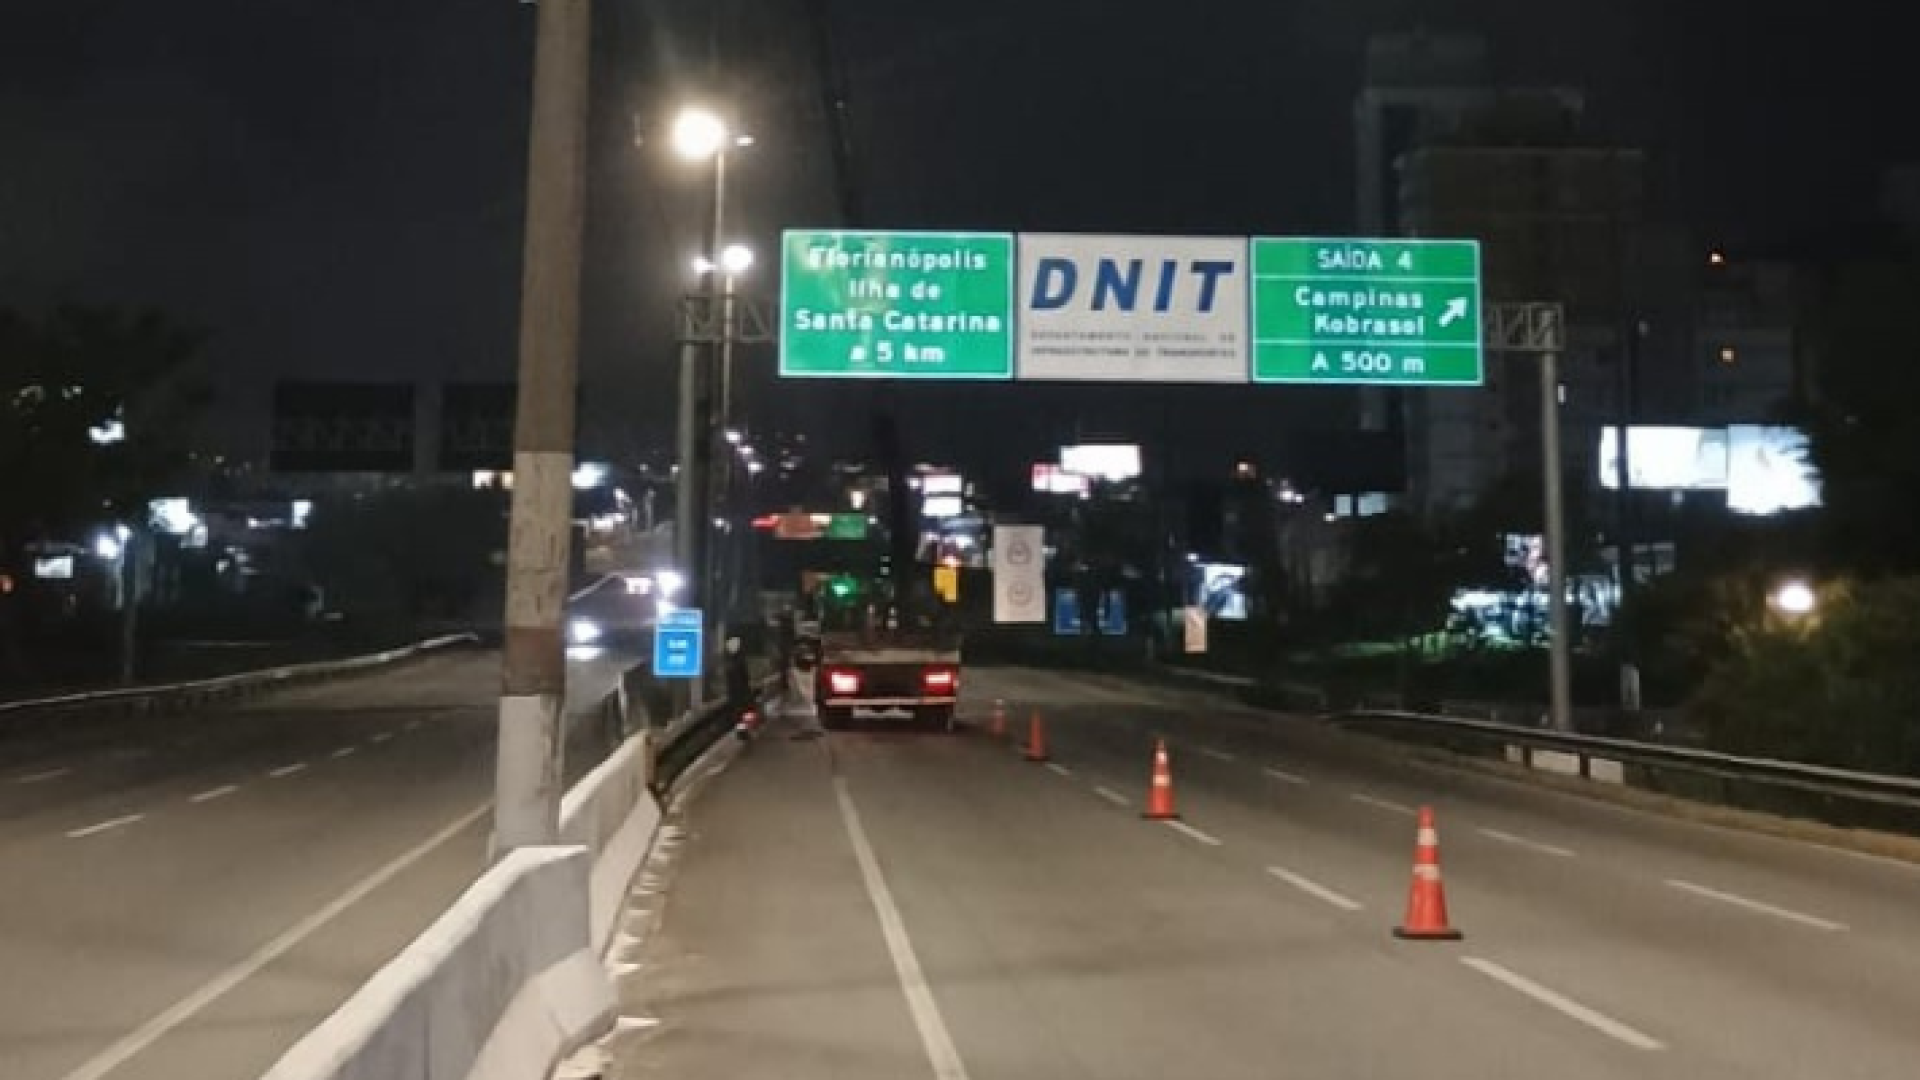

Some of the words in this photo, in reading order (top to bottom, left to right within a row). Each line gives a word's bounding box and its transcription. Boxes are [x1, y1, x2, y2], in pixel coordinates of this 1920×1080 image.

[1318, 246, 1383, 271] SAÍDA
[1396, 250, 1413, 271] 4
[850, 278, 900, 300] Ilha
[910, 280, 942, 301] de
[1030, 258, 1234, 313] DNIT
[1295, 285, 1424, 311] Campinas
[794, 308, 873, 331] Santa
[884, 310, 1001, 333] Catarina
[1315, 312, 1424, 335] Kobrasol
[850, 345, 867, 361] a
[877, 340, 894, 363] 5
[904, 342, 946, 363] km
[1312, 351, 1329, 371] A
[1341, 351, 1392, 373] 500
[1402, 356, 1425, 373] m
